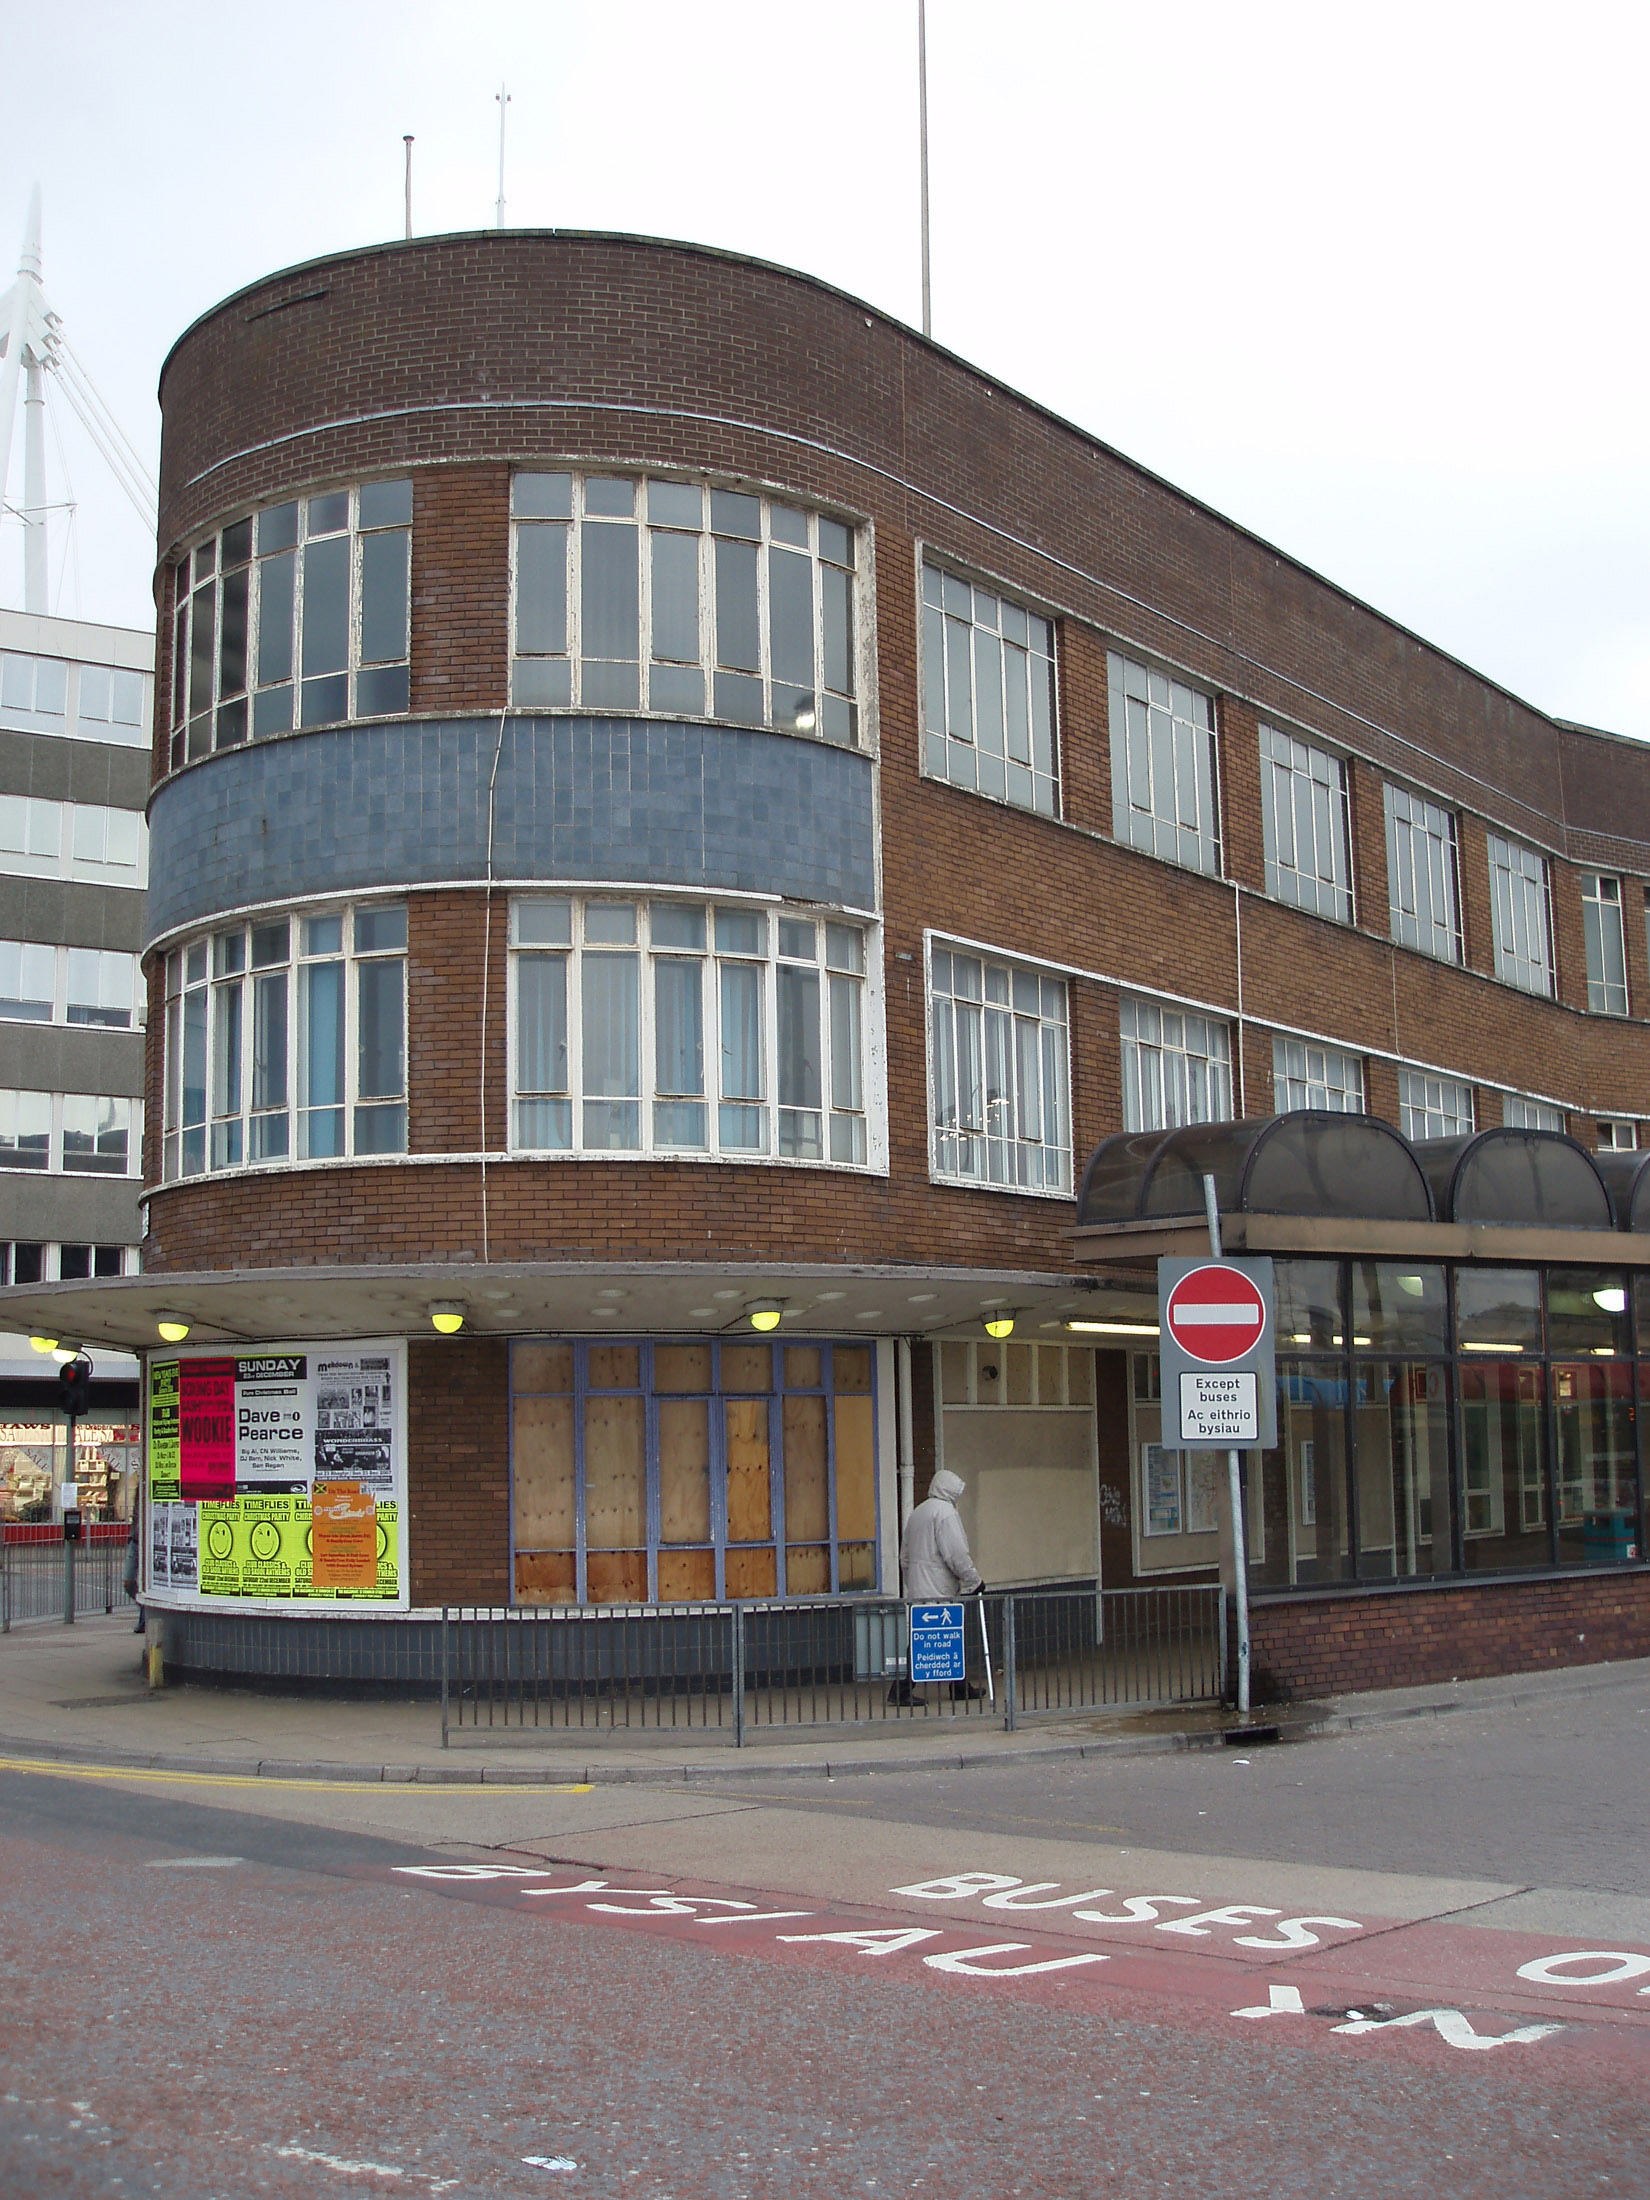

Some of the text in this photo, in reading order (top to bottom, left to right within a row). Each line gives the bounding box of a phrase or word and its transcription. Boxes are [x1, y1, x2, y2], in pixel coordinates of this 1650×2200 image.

[238, 1359, 301, 1373] SUNDAY
[214, 1380, 230, 1396] DAY
[1196, 1378, 1240, 1390] Except
[1200, 1391, 1238, 1402] buses
[238, 1408, 280, 1423] Dave
[1187, 1408, 1251, 1420] Ac eithrio
[182, 1415, 232, 1444] WOOKIE
[239, 1426, 304, 1441] Pearce
[1198, 1423, 1240, 1436] bysiau
[25, 1448, 49, 1471] SALE
[202, 1501, 240, 1510] TIME FLIES
[244, 1500, 289, 1510] TIME FLIES
[226, 1512, 240, 1520] PARTY
[244, 1512, 290, 1521] CHRISTMAS PARTY
[377, 1512, 397, 1522] PARTY
[266, 1568, 290, 1576] ANTHEMS
[914, 1632, 924, 1640] Do
[928, 1632, 940, 1640] not
[934, 1640, 952, 1648] road
[917, 1652, 950, 1661] Peidiwch
[914, 1660, 950, 1670] cherdded
[932, 1668, 952, 1677] fford
[391, 1864, 1110, 1976] BYSIAU
[888, 1871, 1650, 1996] BUSES O
